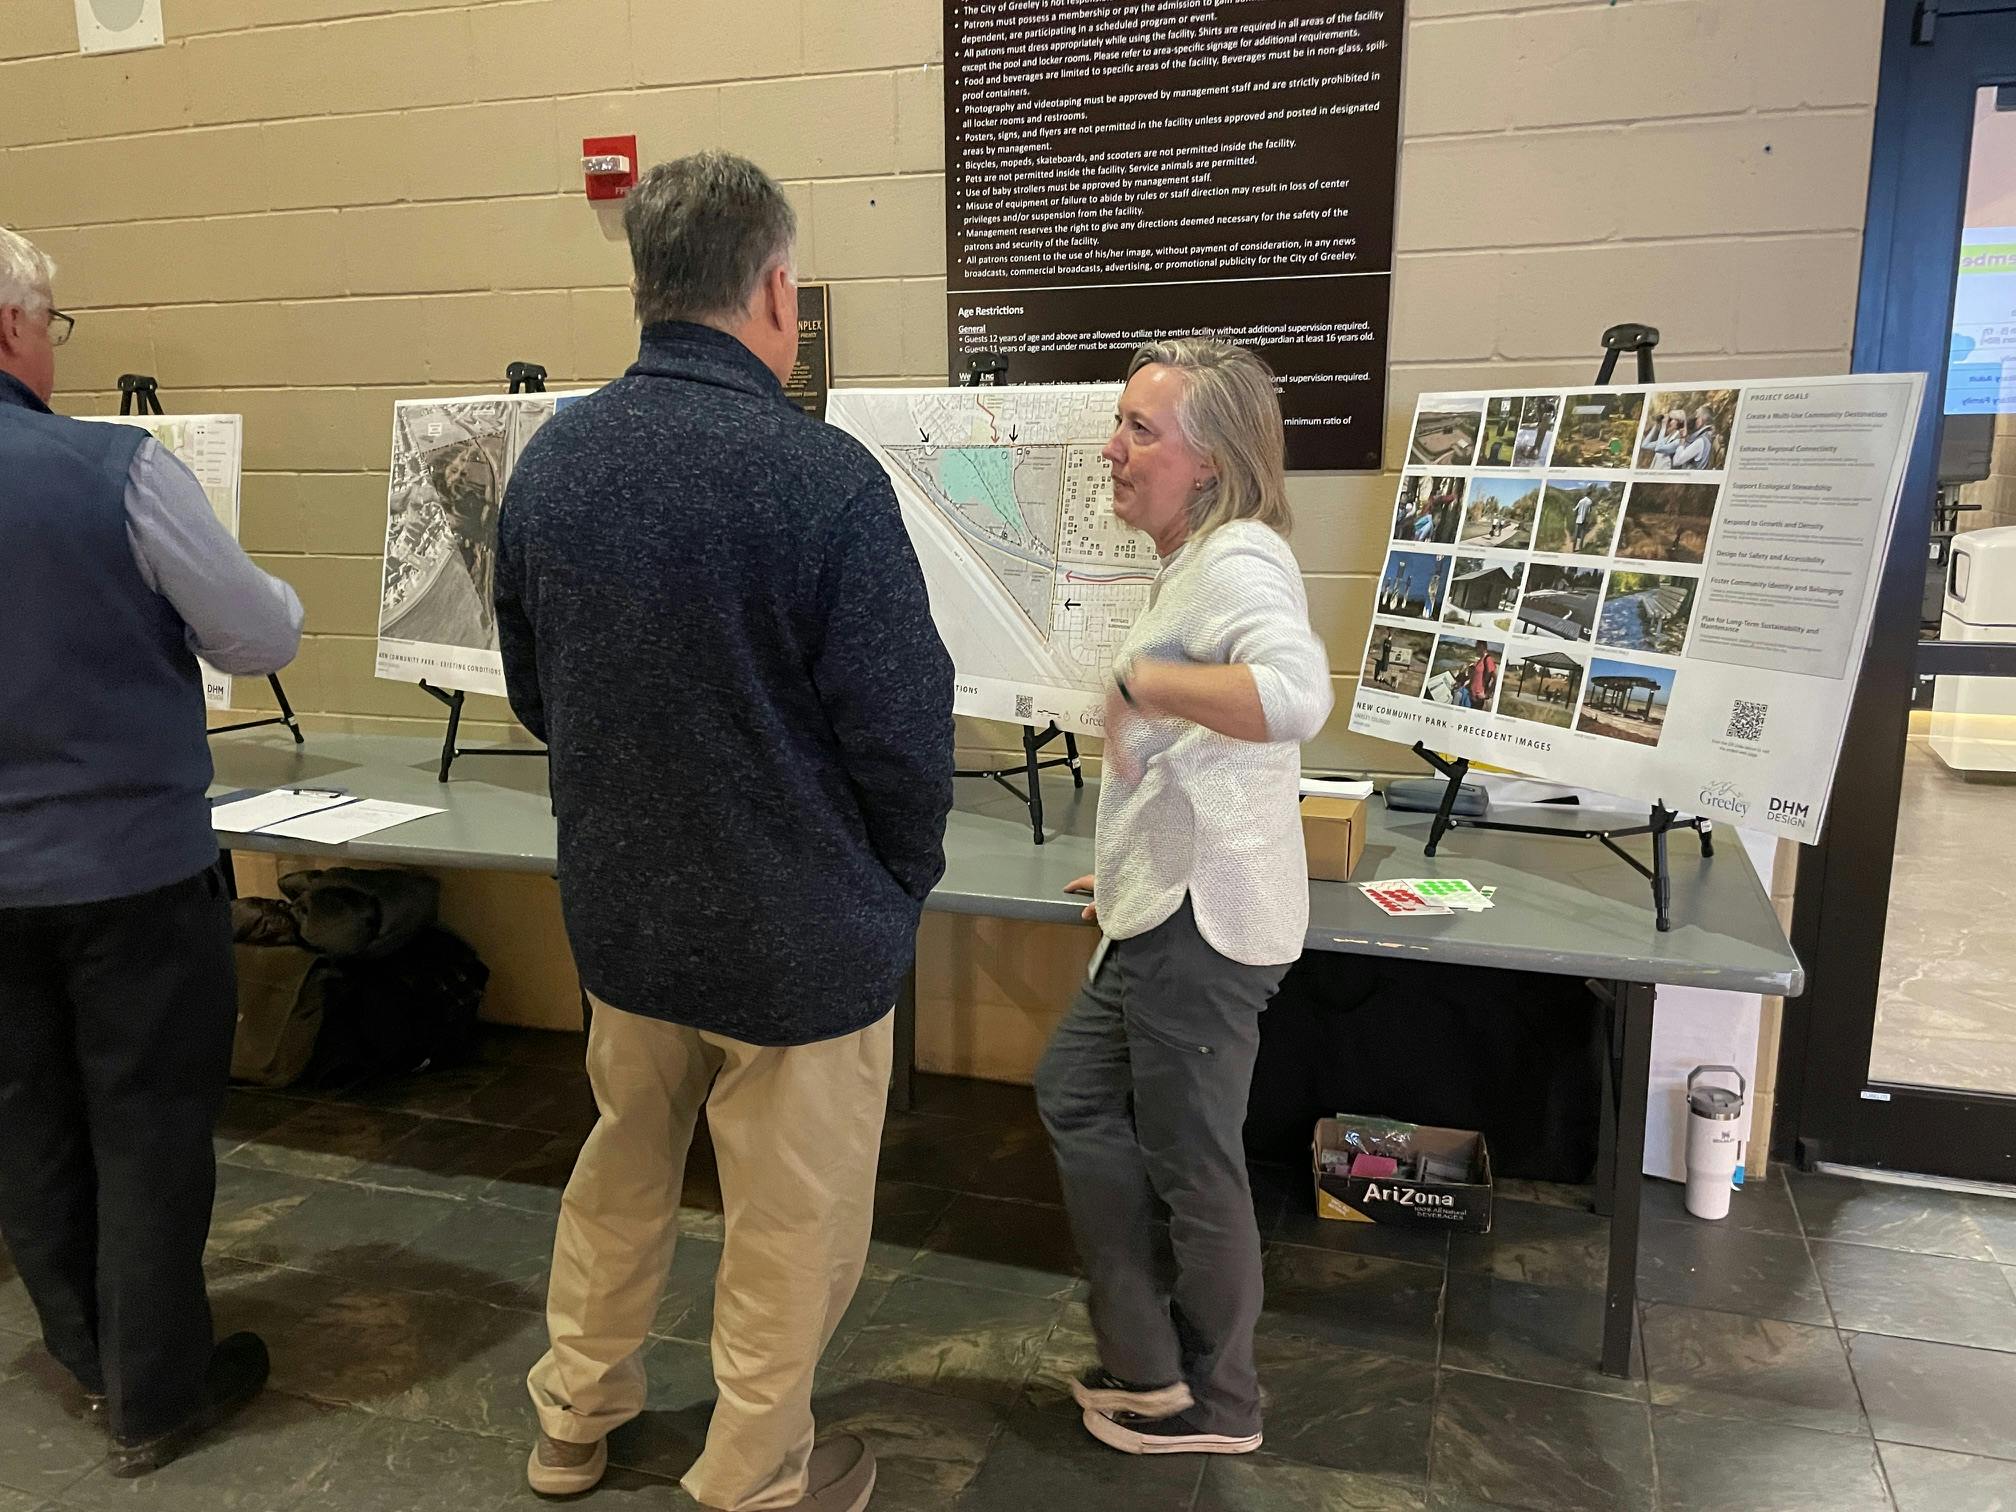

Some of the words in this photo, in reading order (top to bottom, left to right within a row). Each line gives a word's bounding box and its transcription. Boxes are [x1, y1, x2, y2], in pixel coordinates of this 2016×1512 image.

[961, 30, 1007, 45] dependent,
[1009, 31, 1022, 39] are
[1024, 24, 1076, 40] participating
[1078, 24, 1086, 33] in
[1095, 18, 1138, 32] scheduled
[1140, 16, 1176, 29] program
[1178, 15, 1188, 24] or
[1190, 11, 1217, 22] event.
[962, 118, 972, 128] all
[974, 116, 998, 127] locker
[1000, 116, 1024, 125] rooms
[1026, 113, 1042, 123] and
[1044, 111, 1087, 122] restrooms.
[965, 158, 998, 171] Bicycles,
[1000, 156, 1034, 168] mopeds,
[1036, 152, 1087, 166] skateboards,
[1089, 151, 1105, 161] and
[1106, 150, 1141, 160] scooters
[1143, 149, 1157, 158] are
[1159, 148, 1173, 156] not
[1176, 143, 1218, 156] permitted
[1220, 141, 1246, 152] inside
[1248, 140, 1263, 150] the
[1265, 137, 1296, 150] facility.
[965, 174, 981, 183] Pets
[998, 172, 1012, 181] not
[1014, 169, 1054, 181] permitted
[1056, 167, 1079, 177] inside
[1082, 166, 1095, 176] the
[1098, 163, 1126, 176] facility.
[1129, 162, 1159, 173] Service
[1161, 159, 1193, 170] animals
[1195, 160, 1209, 168] are
[1211, 155, 1257, 168] permitted.
[965, 187, 980, 197] Use
[982, 186, 990, 196] of
[992, 185, 1011, 197] baby
[1013, 183, 1045, 194] strollers
[1047, 183, 1067, 192] must
[1069, 181, 1079, 190] be
[1082, 179, 1120, 191] approved
[1122, 178, 1132, 188] by
[1134, 175, 1188, 188] management
[1191, 172, 1211, 183] staff.
[957, 306, 974, 317] Age
[975, 304, 1024, 316] Restrictions
[958, 324, 985, 334] General
[964, 334, 987, 343] Guests
[1018, 333, 1026, 341] of
[1056, 332, 1077, 340] above
[1092, 330, 1120, 339] allowed
[1131, 329, 1152, 338] utilize
[1154, 328, 1166, 337] the
[1168, 328, 1190, 336] entire
[1191, 326, 1215, 336] facility
[1216, 326, 1246, 336] without
[1248, 324, 1286, 333] additional
[1287, 322, 1332, 333] supervision
[1334, 321, 1370, 331] required.
[1233, 334, 1294, 346] parent/guardian
[1305, 334, 1323, 342] at
[1326, 333, 1336, 341] least
[1337, 334, 1358, 342] 16
[1359, 332, 1373, 340] years
[1359, 332, 1375, 341] old.
[999, 342, 1017, 353] years
[1027, 341, 1040, 352] age
[1056, 342, 1077, 350] under
[1108, 341, 1145, 350] accompan
[1289, 374, 1333, 383] supervision
[1334, 372, 1371, 382] required.
[1342, 416, 1351, 424] of
[1783, 554, 1824, 564] Accessibility
[1730, 579, 1766, 588] Community
[1767, 582, 1793, 591] Identity
[1809, 586, 1843, 596] Belonging
[1700, 623, 1739, 633] Maintenance
[1726, 618, 1759, 628] Long-Term
[1760, 622, 1804, 634] Sustainability
[208, 684, 224, 694] DHM
[956, 685, 978, 694] TIONS
[1356, 702, 1373, 711] NEW
[1376, 706, 1422, 723] COMMUNITY
[1425, 717, 1448, 728] PARK
[1457, 724, 1512, 742] PRECEDENT
[1515, 737, 1551, 752] IMAGES
[1700, 790, 1749, 818] Greeley
[1769, 797, 1809, 818] DHM
[1767, 812, 1806, 828] DESIGN
[1363, 1183, 1454, 1207] AriZona
